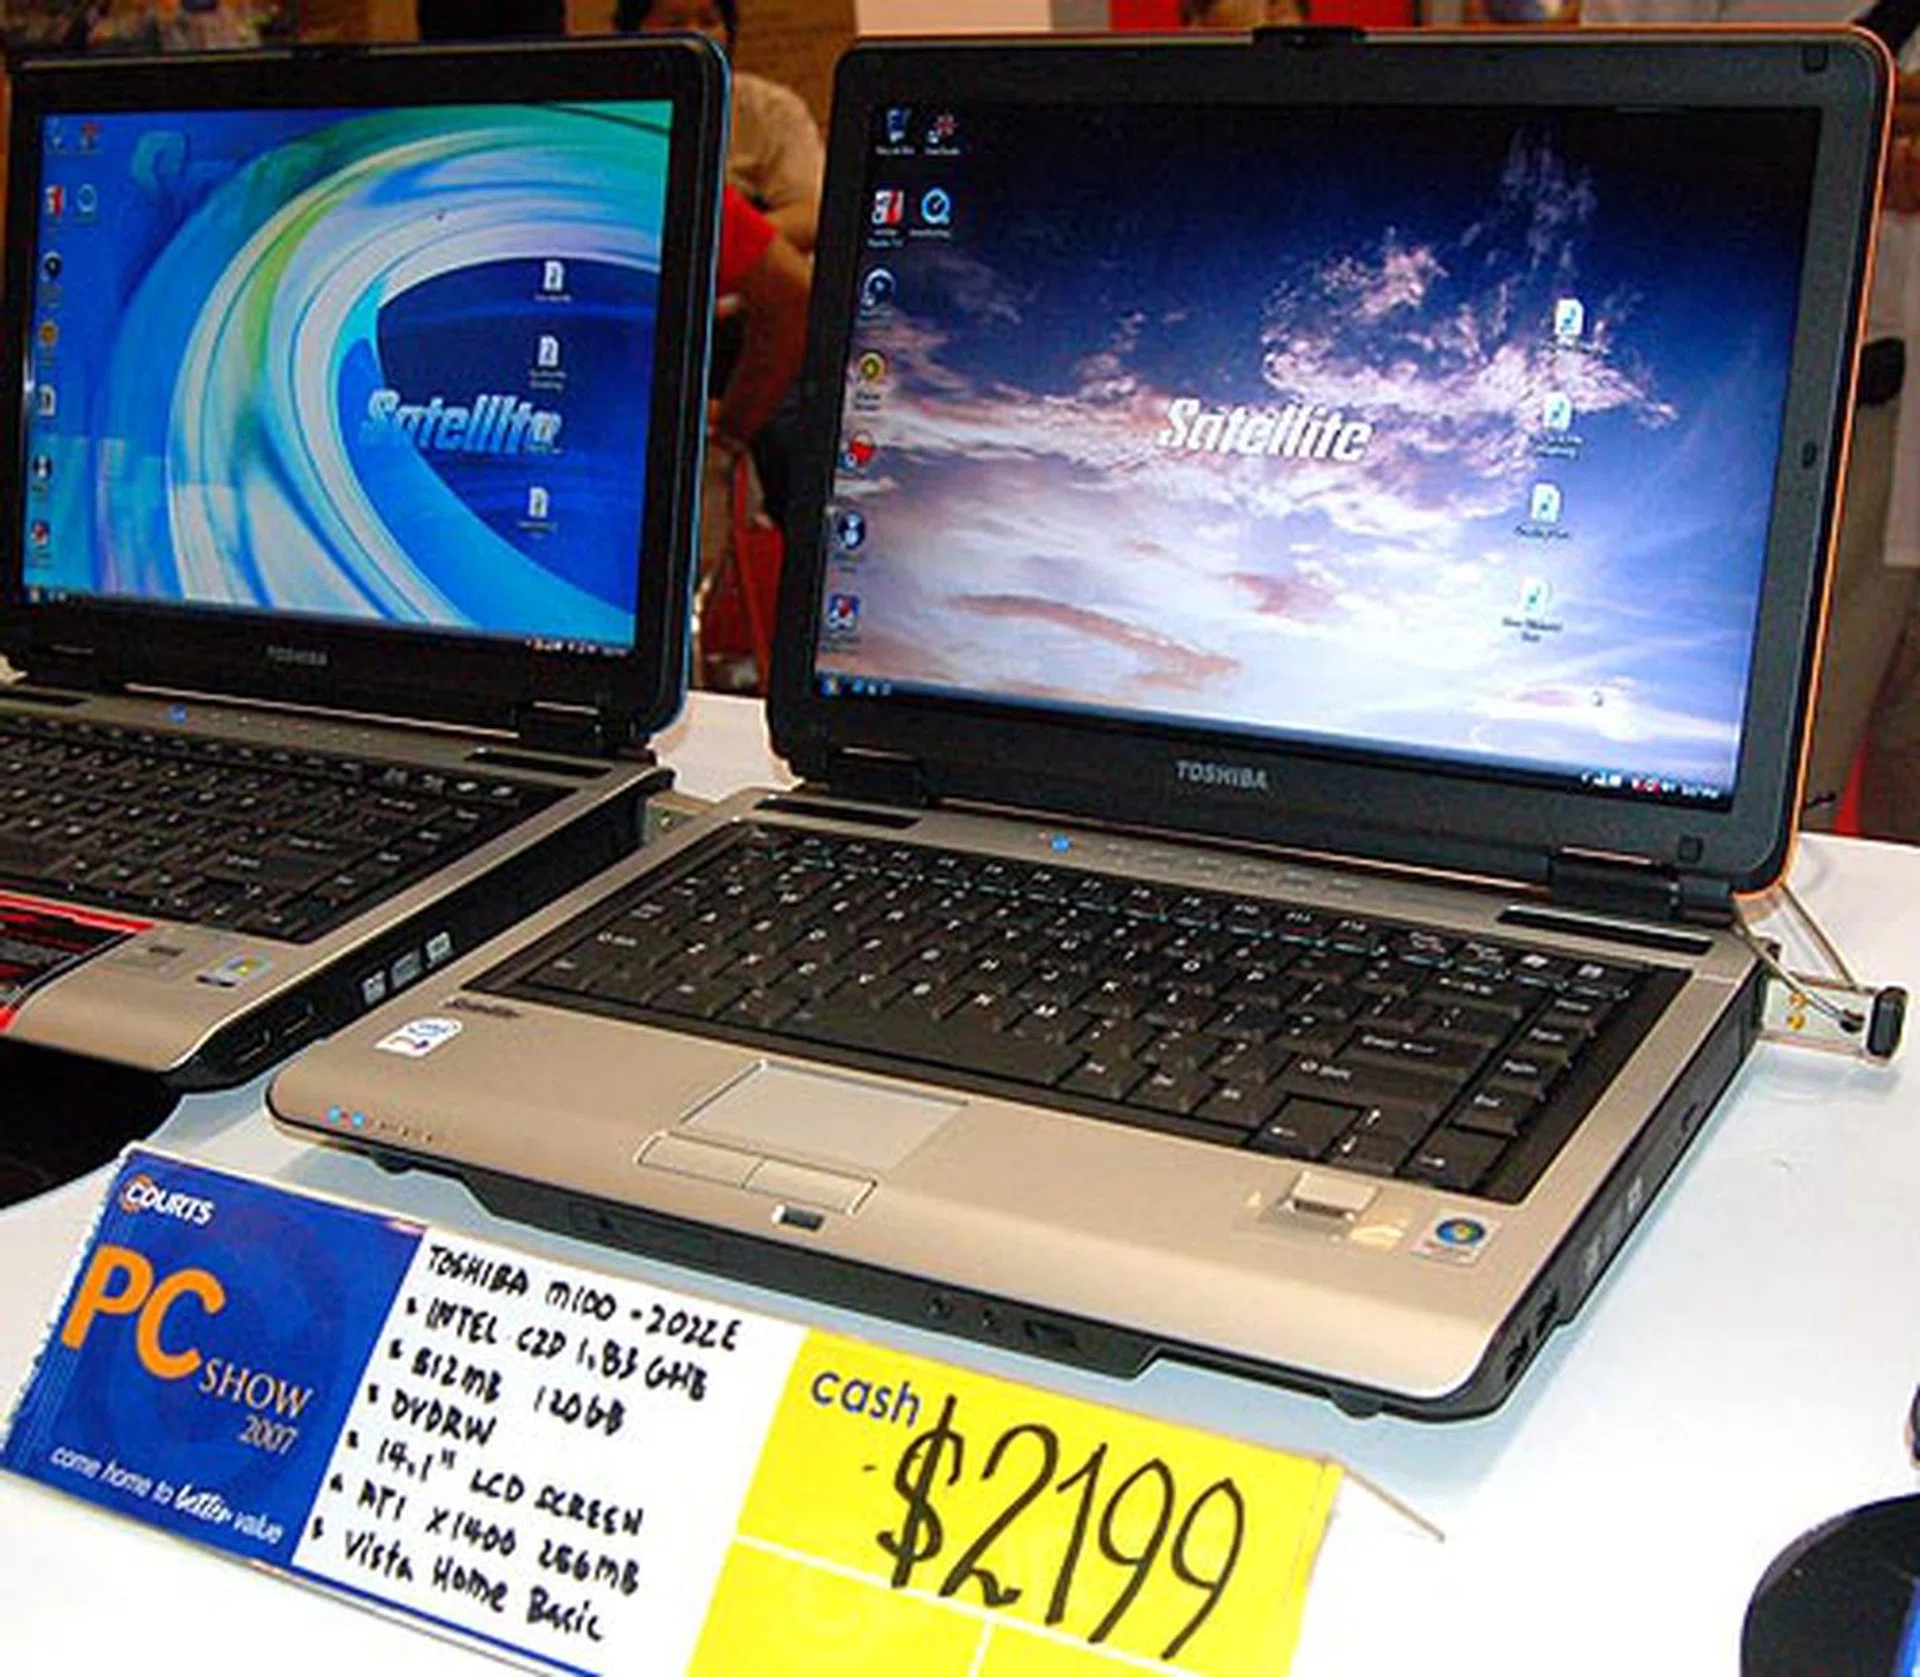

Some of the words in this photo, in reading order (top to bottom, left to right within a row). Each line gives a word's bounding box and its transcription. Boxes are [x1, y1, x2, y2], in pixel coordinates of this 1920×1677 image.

[1156, 398, 1373, 462] Satellite
[1176, 760, 1269, 790] TOSHIBA
[122, 1177, 215, 1226] COURTS
[430, 1245, 529, 1296] TOSHIBA
[61, 1244, 226, 1380] PC
[199, 1358, 314, 1418] SHOW
[424, 1297, 498, 1345] INTEL
[516, 1326, 567, 1359] C2D
[576, 1337, 639, 1380] 1.83
[811, 1369, 921, 1428] cash
[237, 1413, 299, 1456] 2007
[50, 1446, 102, 1480] come
[100, 1459, 153, 1498] home
[152, 1480, 175, 1506] to
[173, 1483, 233, 1525] better
[232, 1511, 285, 1544] value
[357, 1479, 406, 1520] ATI
[424, 1506, 516, 1557] X1400
[470, 1468, 525, 1503] LCD
[534, 1485, 644, 1536] SCREEN
[876, 1394, 1247, 1661] $2199
[345, 1530, 414, 1582] Vista
[432, 1556, 508, 1612] Home
[526, 1585, 605, 1641] Basic
